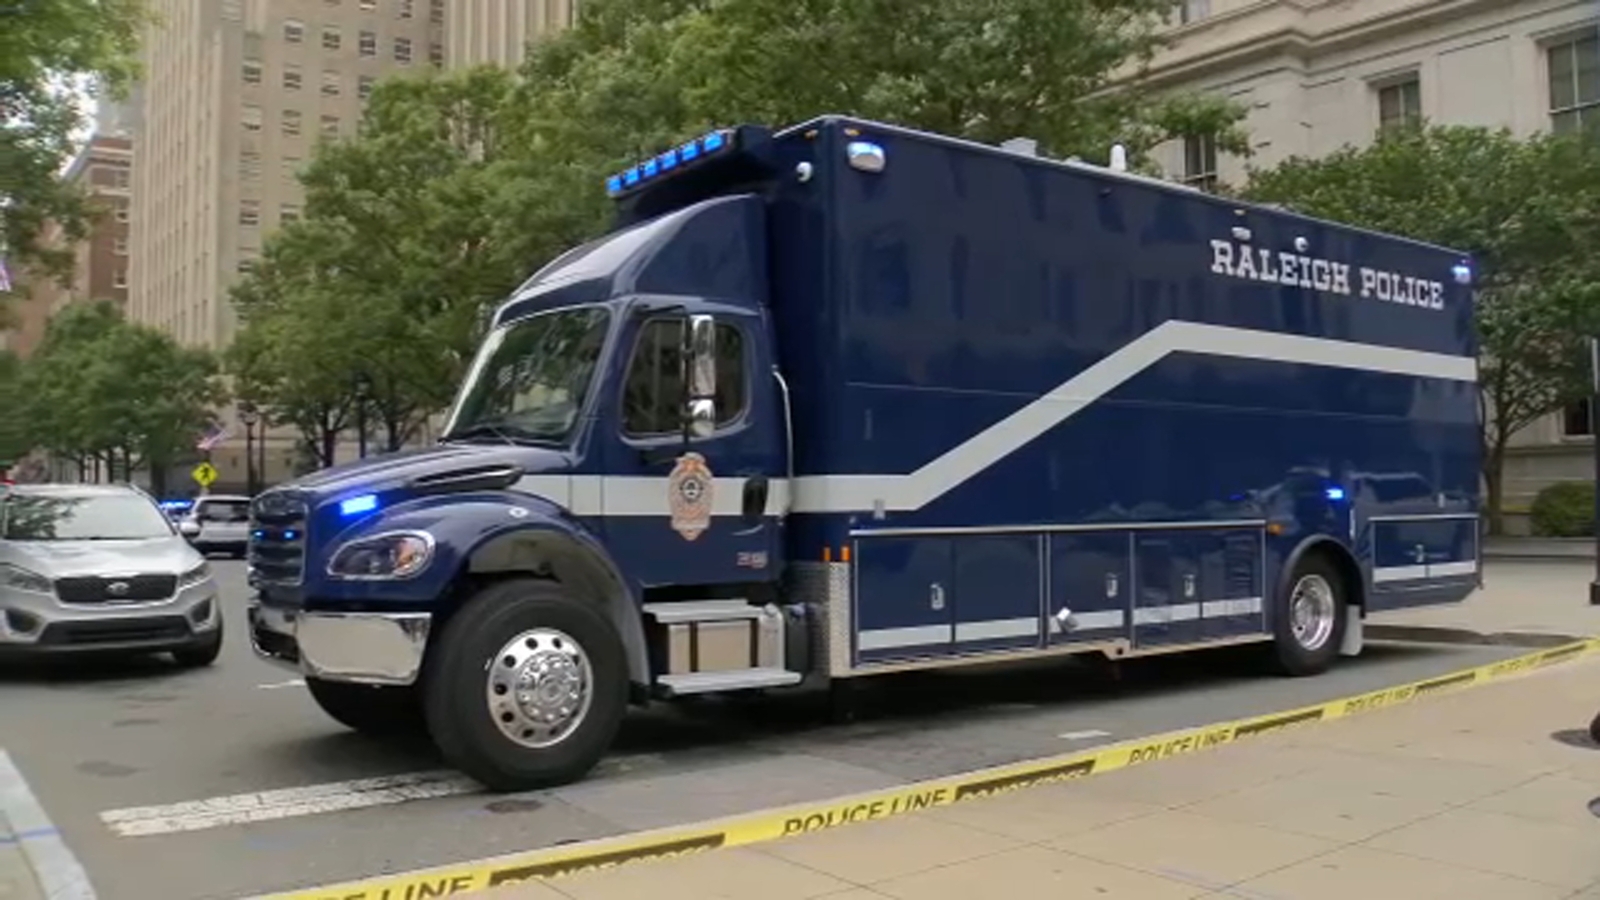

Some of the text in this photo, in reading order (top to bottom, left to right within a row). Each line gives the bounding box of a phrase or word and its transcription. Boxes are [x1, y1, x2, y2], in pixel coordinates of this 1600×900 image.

[1210, 239, 1445, 310] RALEIGH POLICE
[782, 789, 947, 836] POLICE LINE
